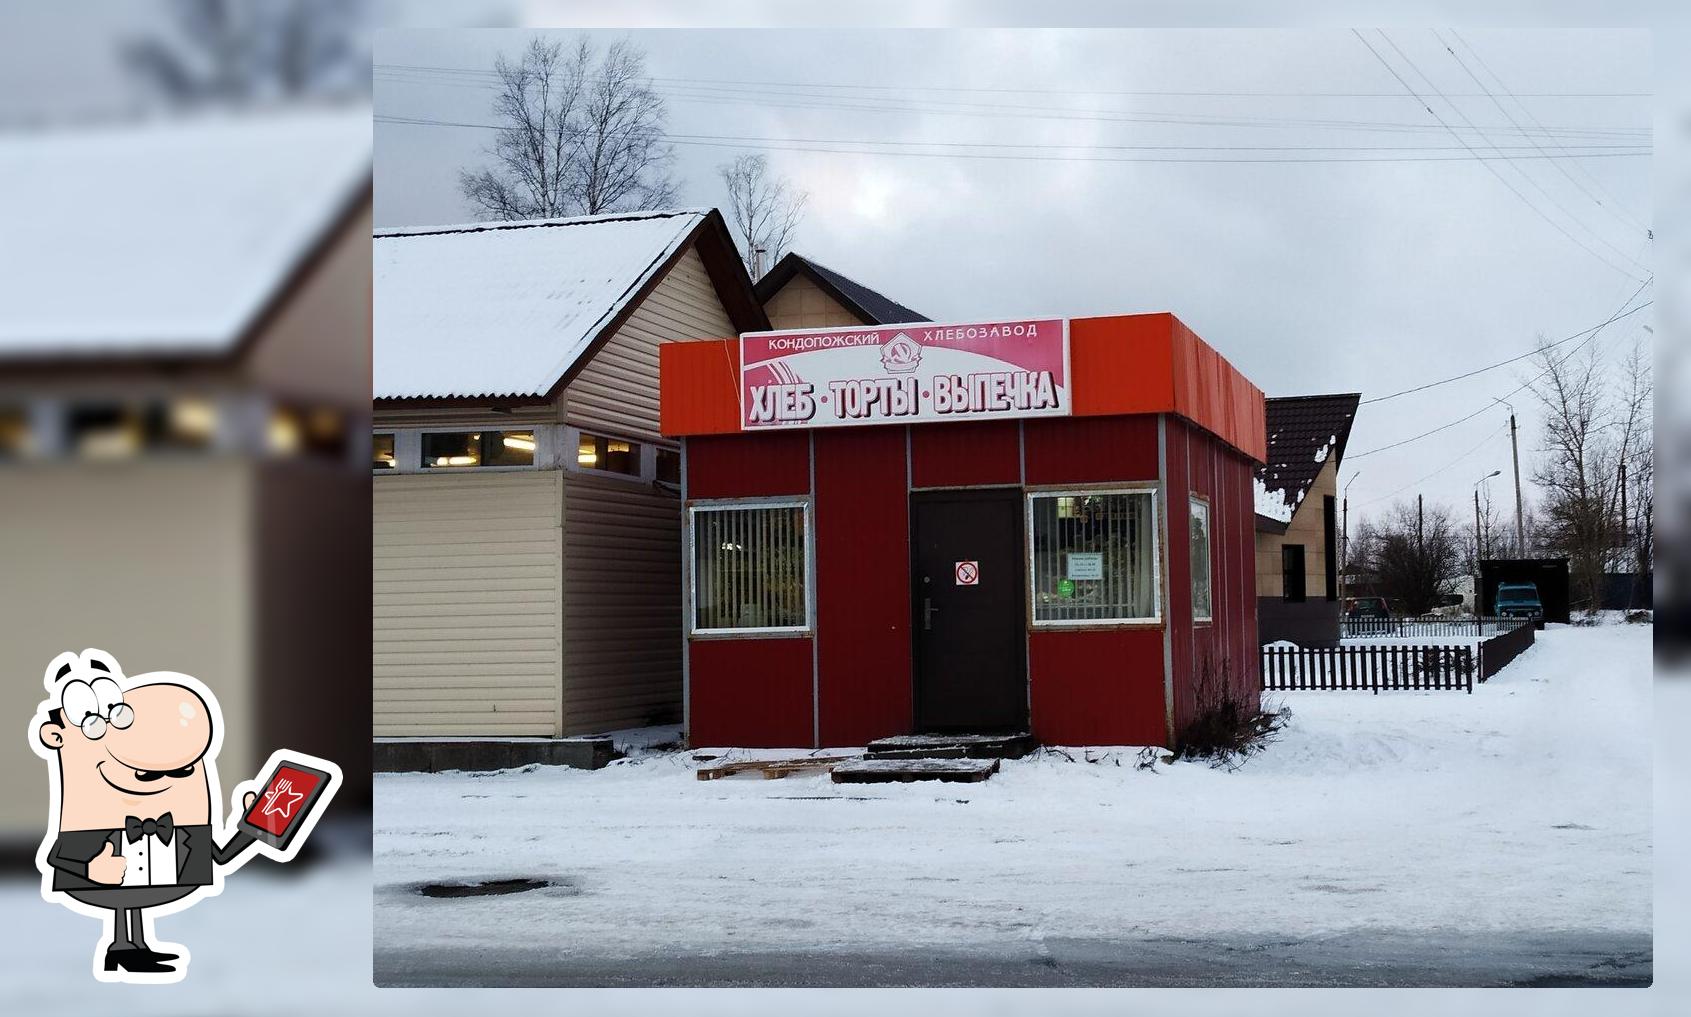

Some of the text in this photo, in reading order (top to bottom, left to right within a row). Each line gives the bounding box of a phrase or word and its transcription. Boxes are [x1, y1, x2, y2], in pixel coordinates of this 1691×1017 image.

[768, 324, 1038, 350] КОНДОПОЖСКИЙ ХЛЕБОЗАВОД
[749, 371, 1060, 422] ХЛЕБ ТОРТЫ ВЫПЕЧКА
